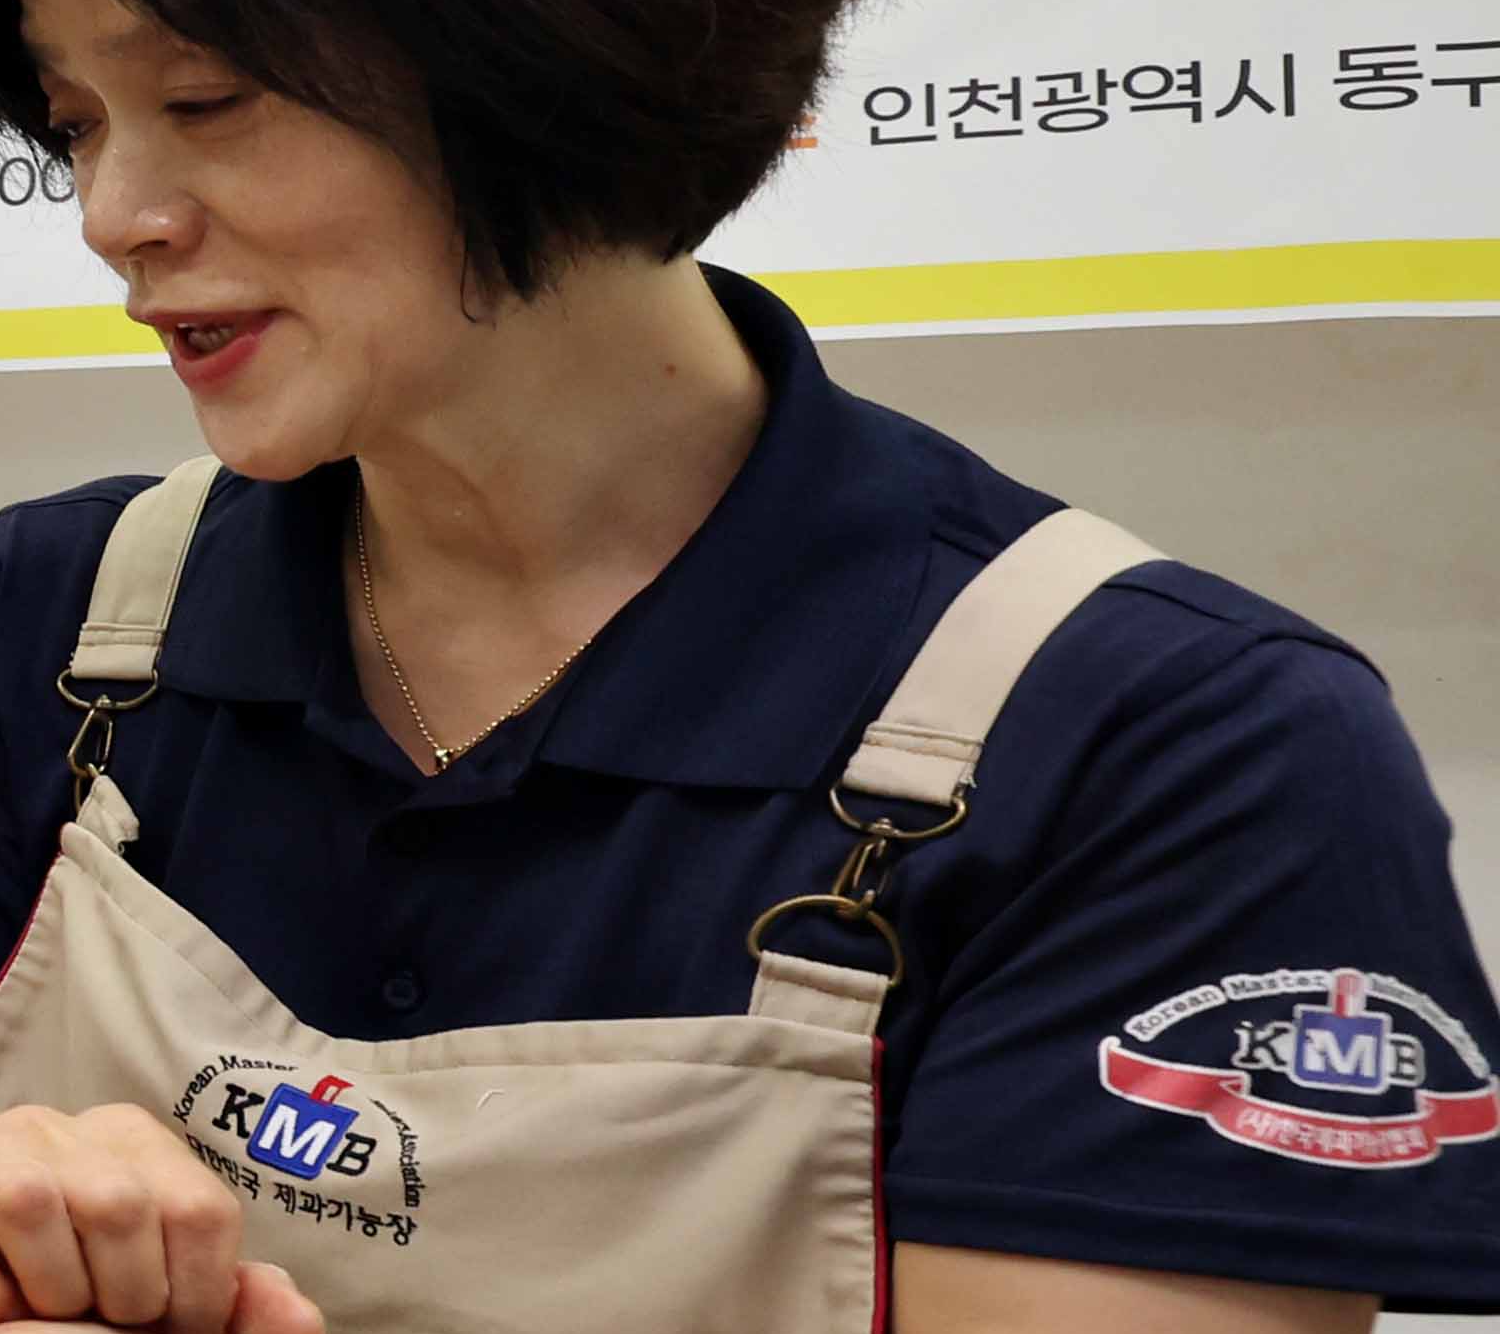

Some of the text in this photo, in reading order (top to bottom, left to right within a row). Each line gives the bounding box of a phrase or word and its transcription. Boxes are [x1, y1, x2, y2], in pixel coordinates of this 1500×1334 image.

[862, 52, 1297, 147] 인천광역시
[1131, 989, 1221, 1037] Korean
[1230, 971, 1327, 996] Master
[1235, 1023, 1422, 1082] KMB
[173, 1064, 219, 1126] Korean
[218, 1054, 300, 1072] Master
[211, 1082, 378, 1178] KMB
[273, 1181, 418, 1247] 제과기능장
